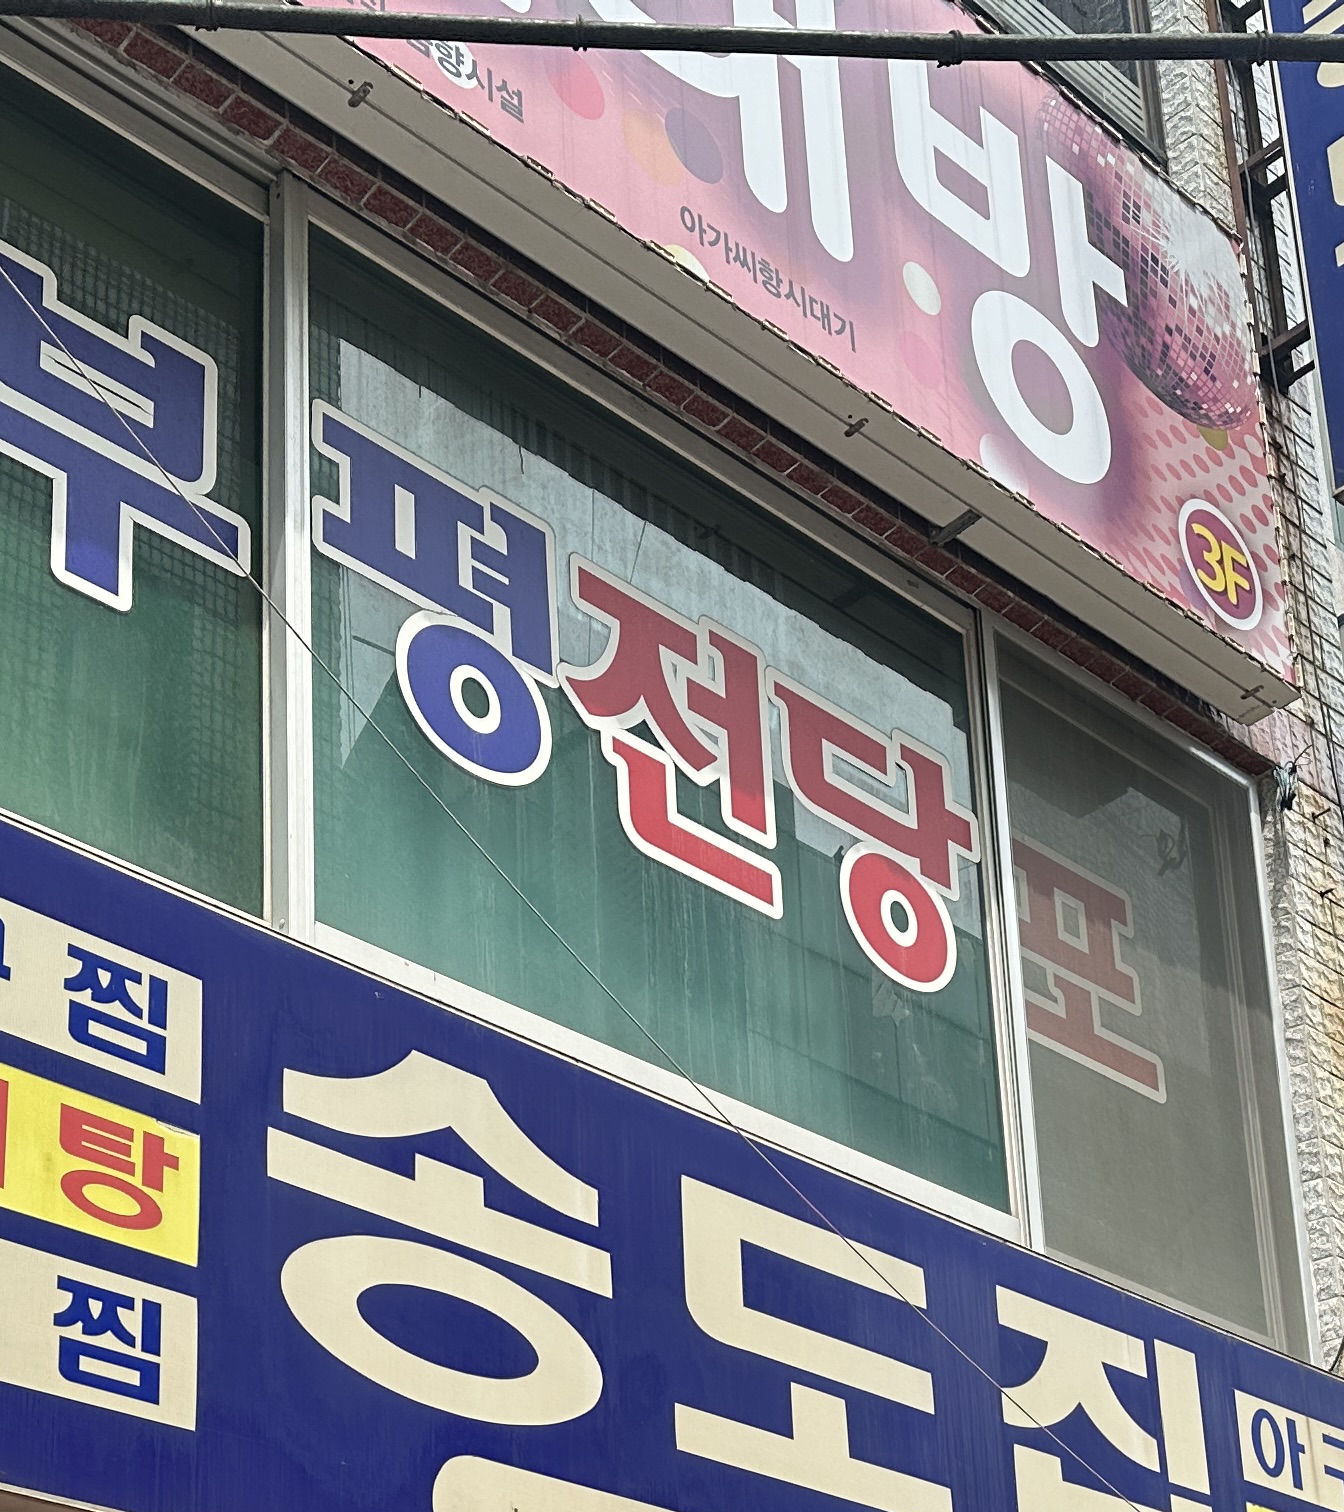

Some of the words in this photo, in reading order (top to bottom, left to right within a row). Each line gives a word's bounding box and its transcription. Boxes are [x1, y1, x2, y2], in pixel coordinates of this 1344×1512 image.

[406, 38, 524, 123] 향시설
[679, 206, 858, 352] 아가씨항시대기
[1191, 522, 1251, 604] 3F
